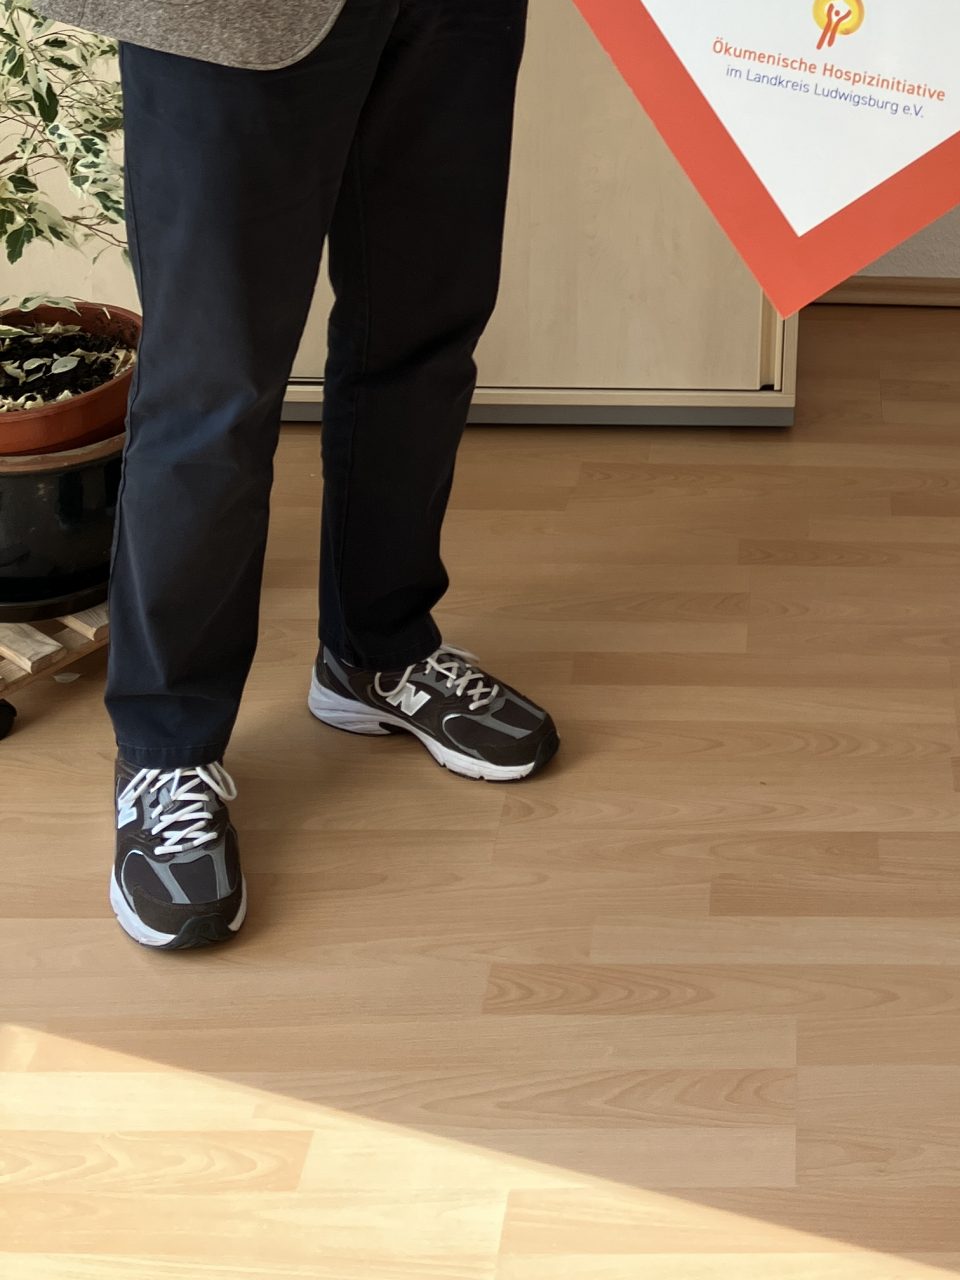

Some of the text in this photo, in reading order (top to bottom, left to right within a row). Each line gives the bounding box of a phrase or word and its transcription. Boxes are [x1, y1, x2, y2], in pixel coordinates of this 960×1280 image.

[711, 36, 946, 102] Ökumenische Hospizinitiative
[725, 65, 925, 119] im Landkreis Ludwigsburg e.V.
[385, 682, 431, 716] N
